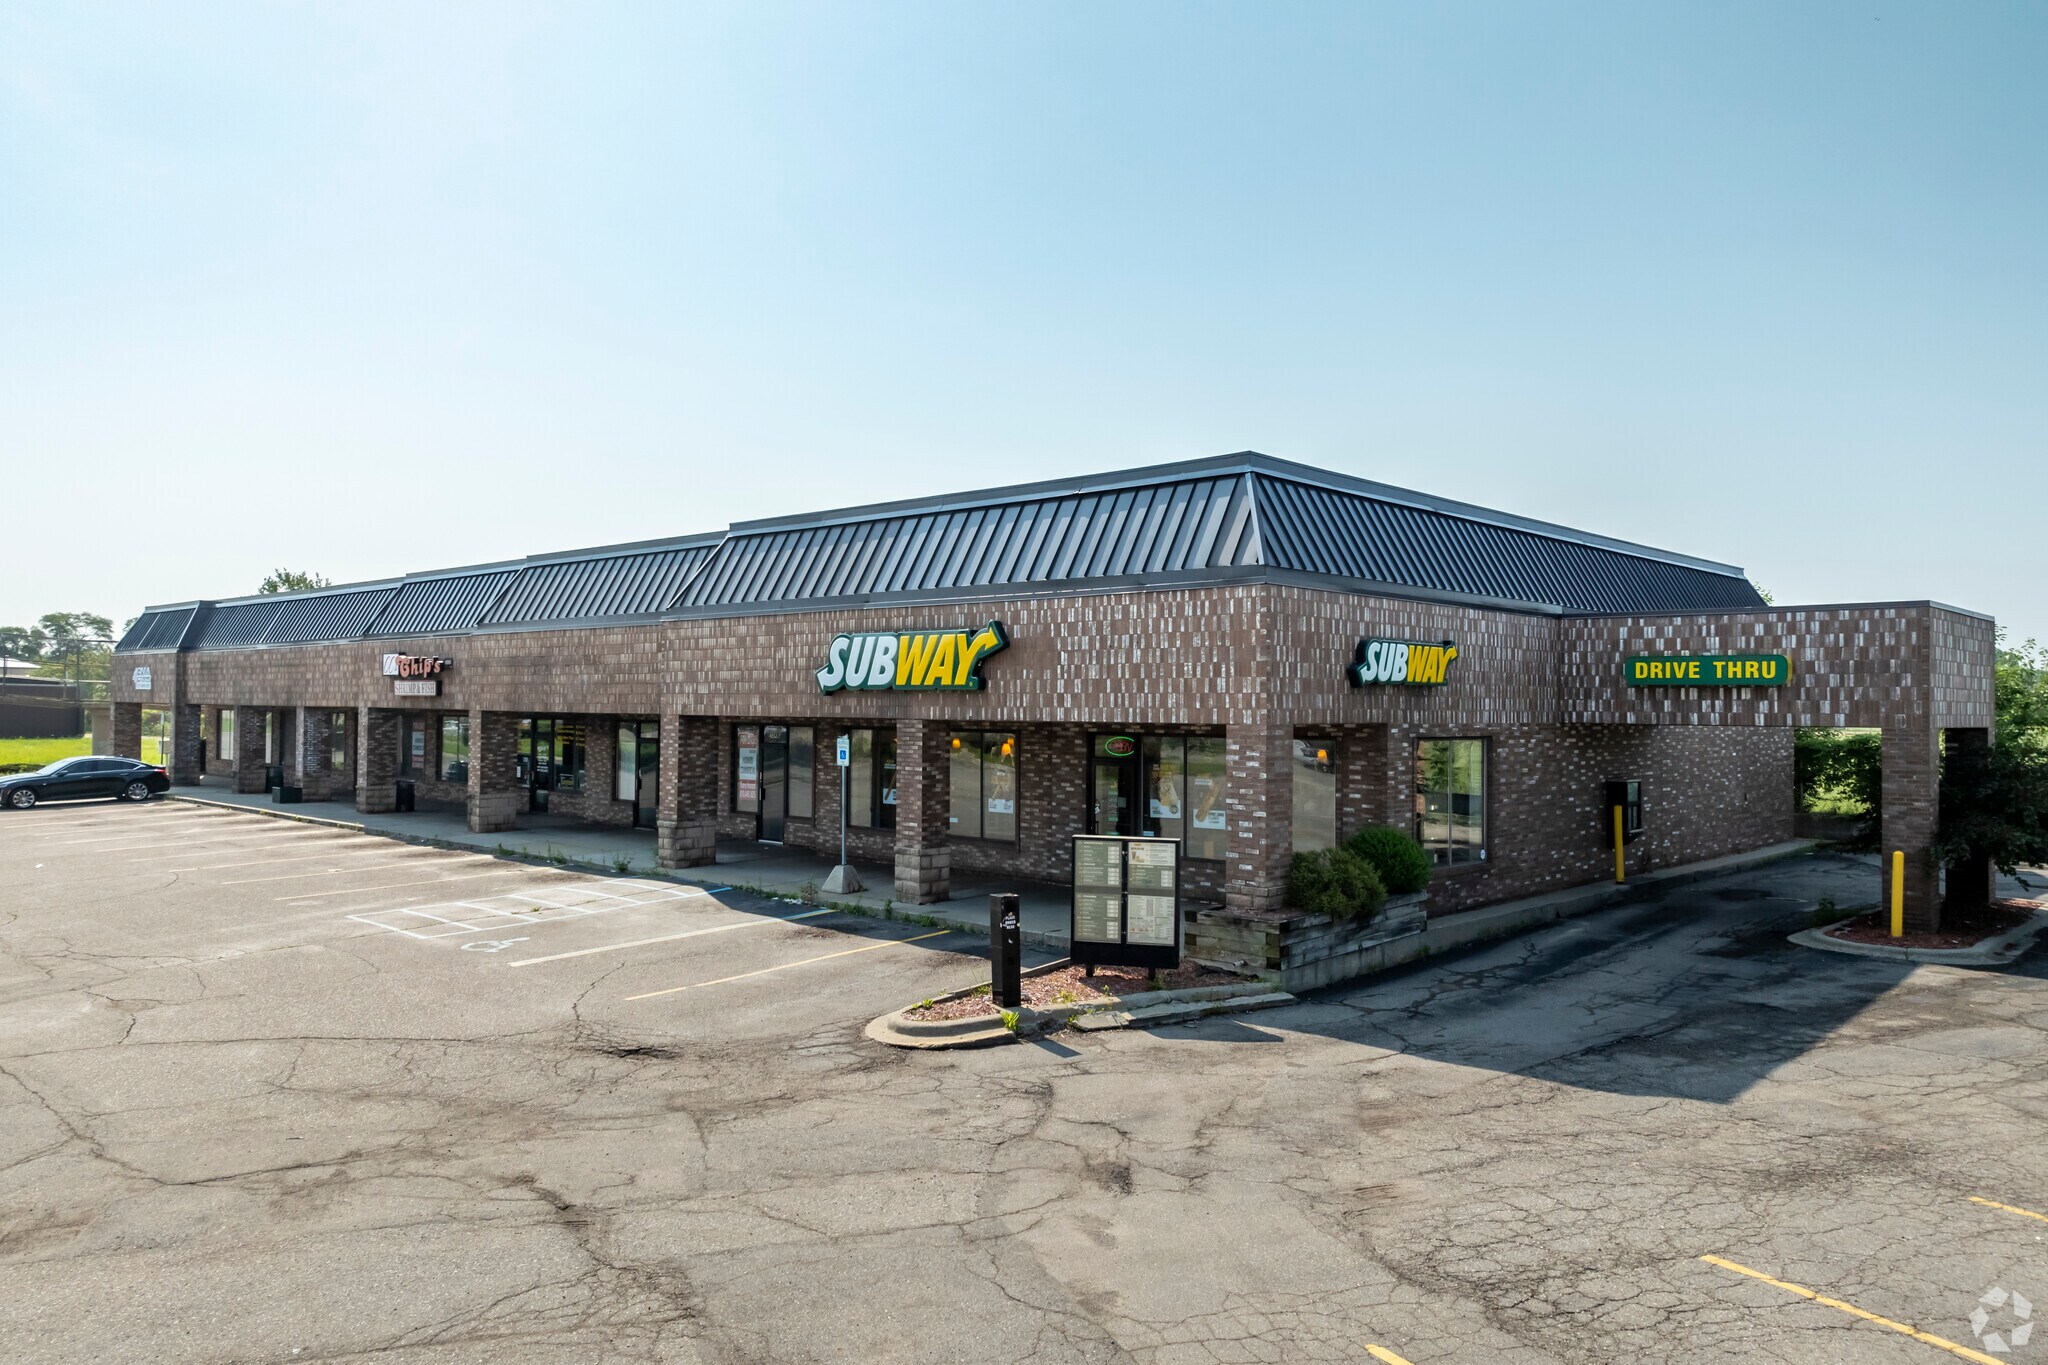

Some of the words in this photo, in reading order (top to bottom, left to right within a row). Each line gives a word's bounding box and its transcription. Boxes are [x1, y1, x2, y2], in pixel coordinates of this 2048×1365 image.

[395, 655, 441, 678] Chip's
[816, 627, 999, 690] SUBWAY
[1360, 641, 1458, 683] SUBWAY
[1635, 661, 1700, 679] DRIVE
[1712, 660, 1777, 679] THRU
[395, 683, 417, 694] SHRIMP
[421, 683, 435, 694] FISH
[1107, 741, 1134, 752] OPEN
